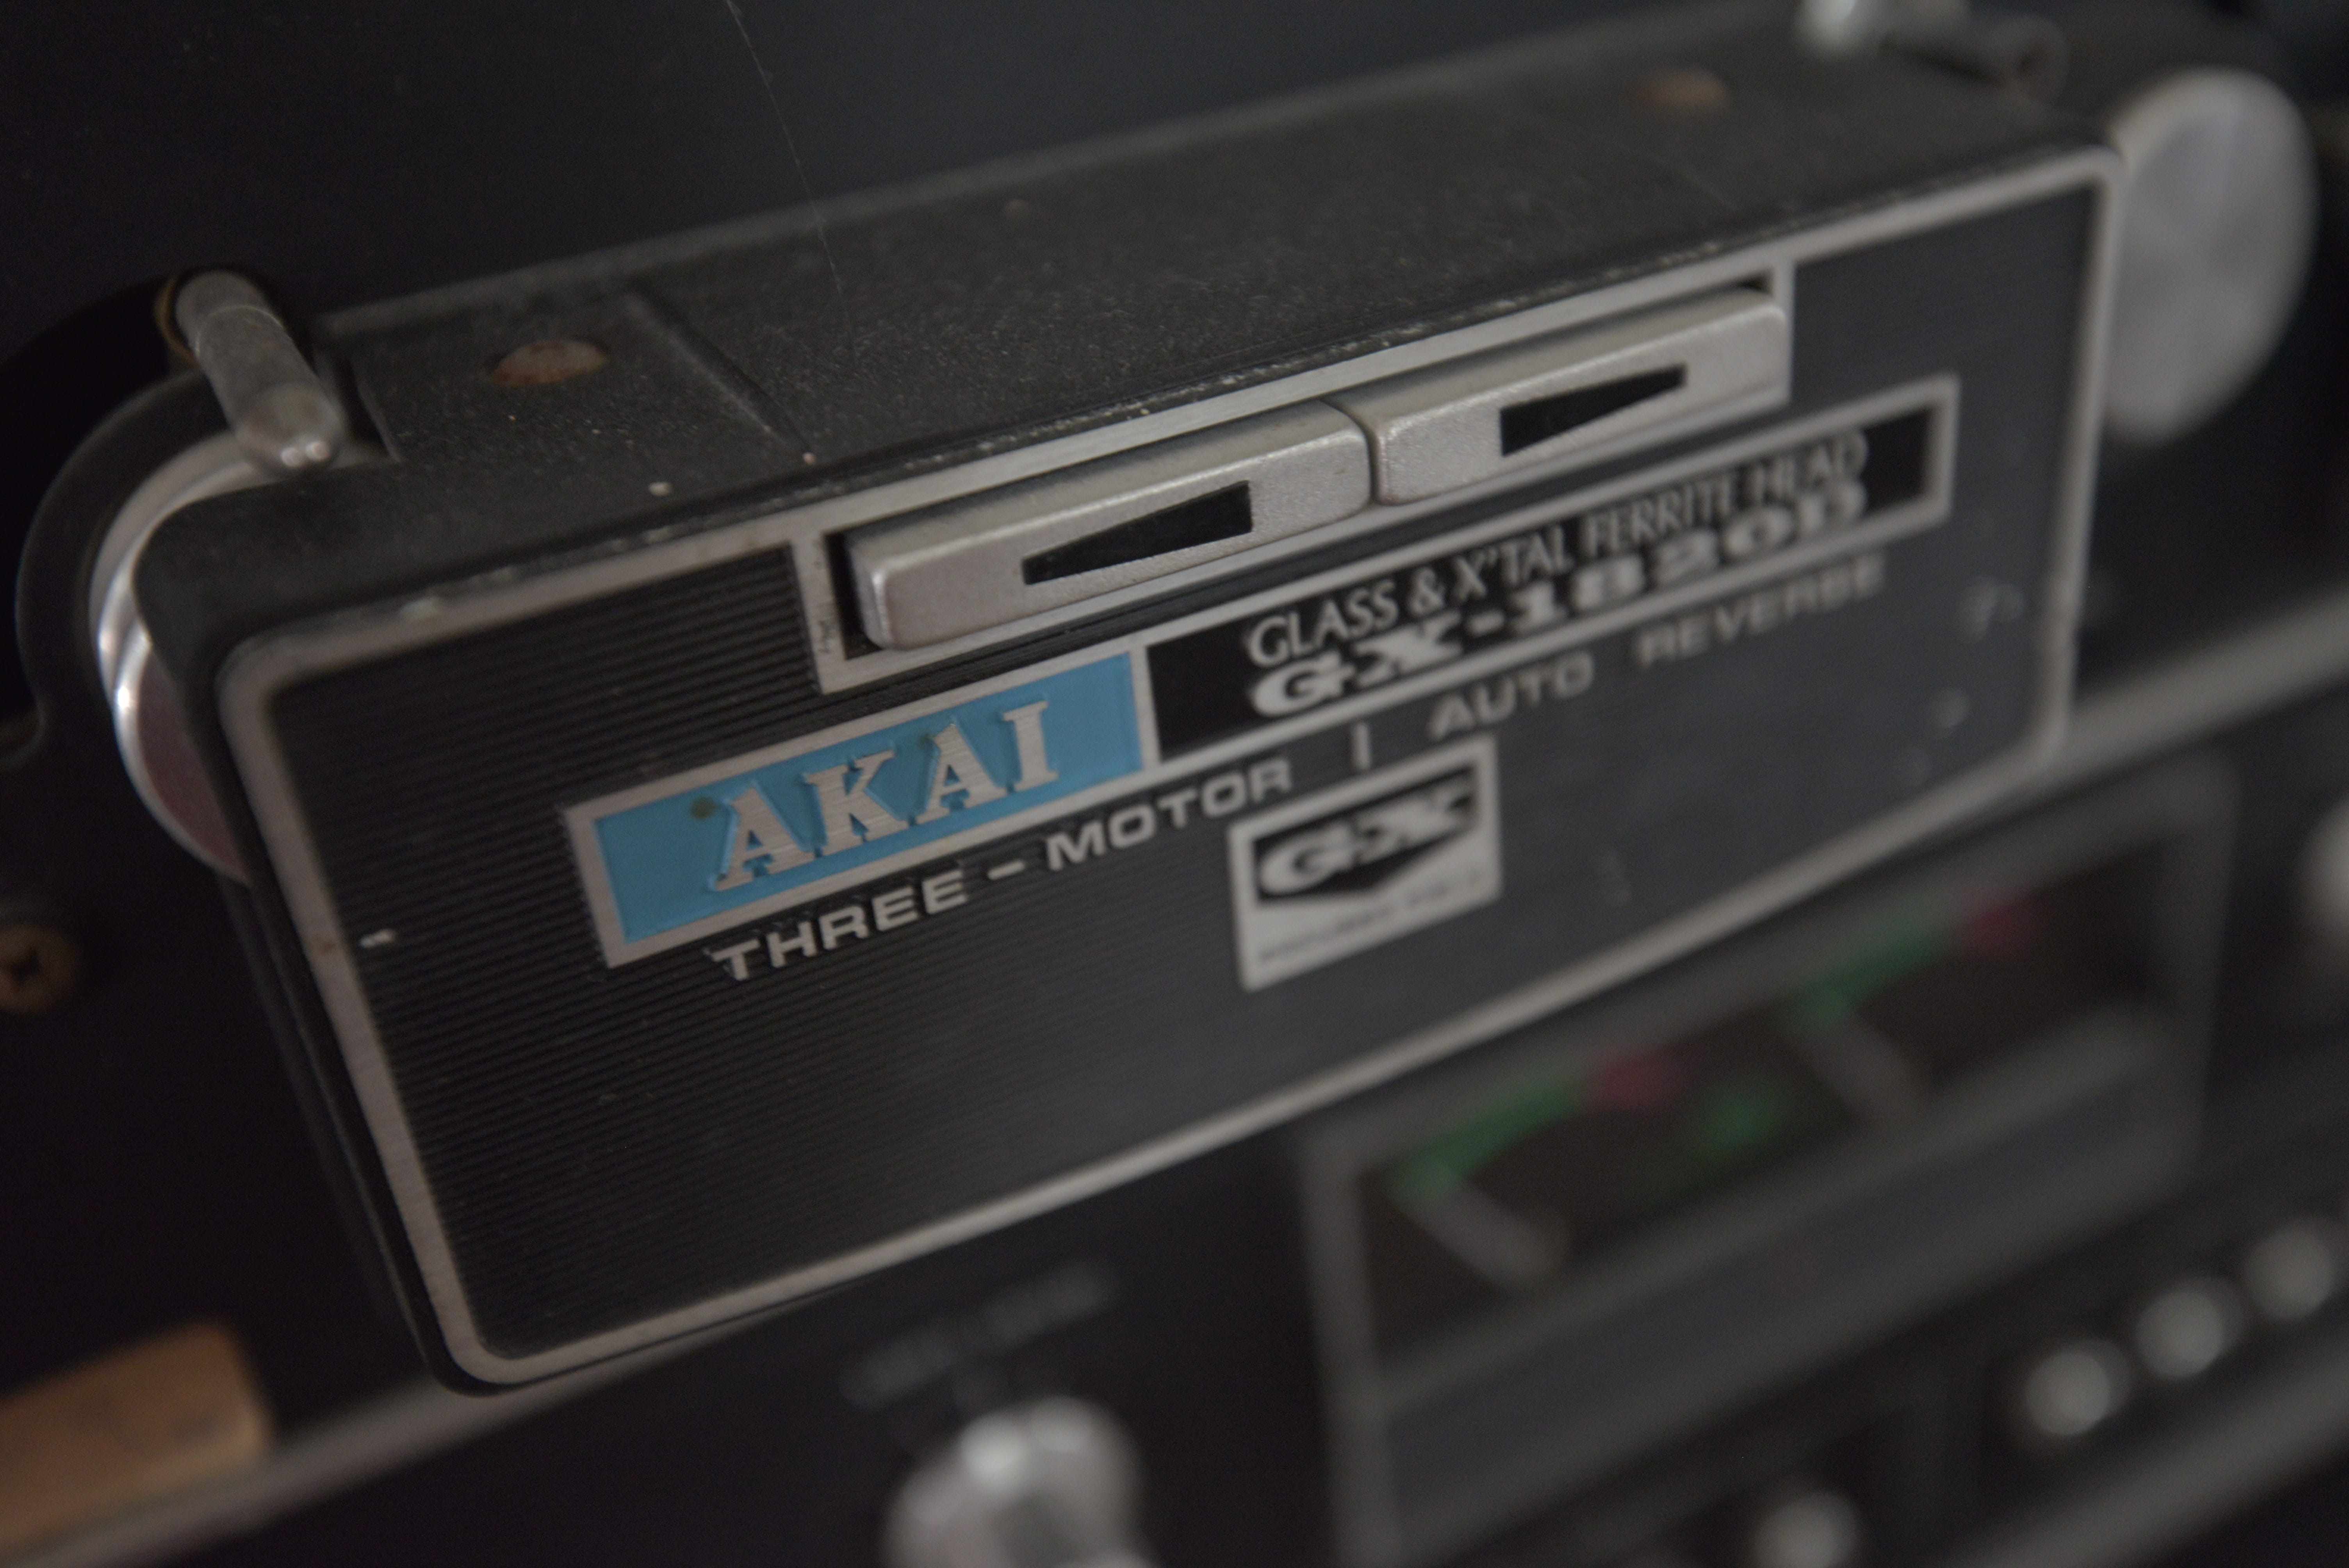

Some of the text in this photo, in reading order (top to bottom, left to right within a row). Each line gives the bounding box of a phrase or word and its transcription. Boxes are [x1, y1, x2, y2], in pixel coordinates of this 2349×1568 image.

[1248, 428, 1869, 668] GLASS & X'TAL FERRITE HEAD
[706, 868, 969, 982] THREE
[1044, 755, 1293, 872] MOTOR
[1425, 649, 1595, 741] AUTO
[1634, 548, 1886, 667] REVERSE
[711, 700, 1059, 893] AKAI
[1257, 783, 1475, 896] GX
